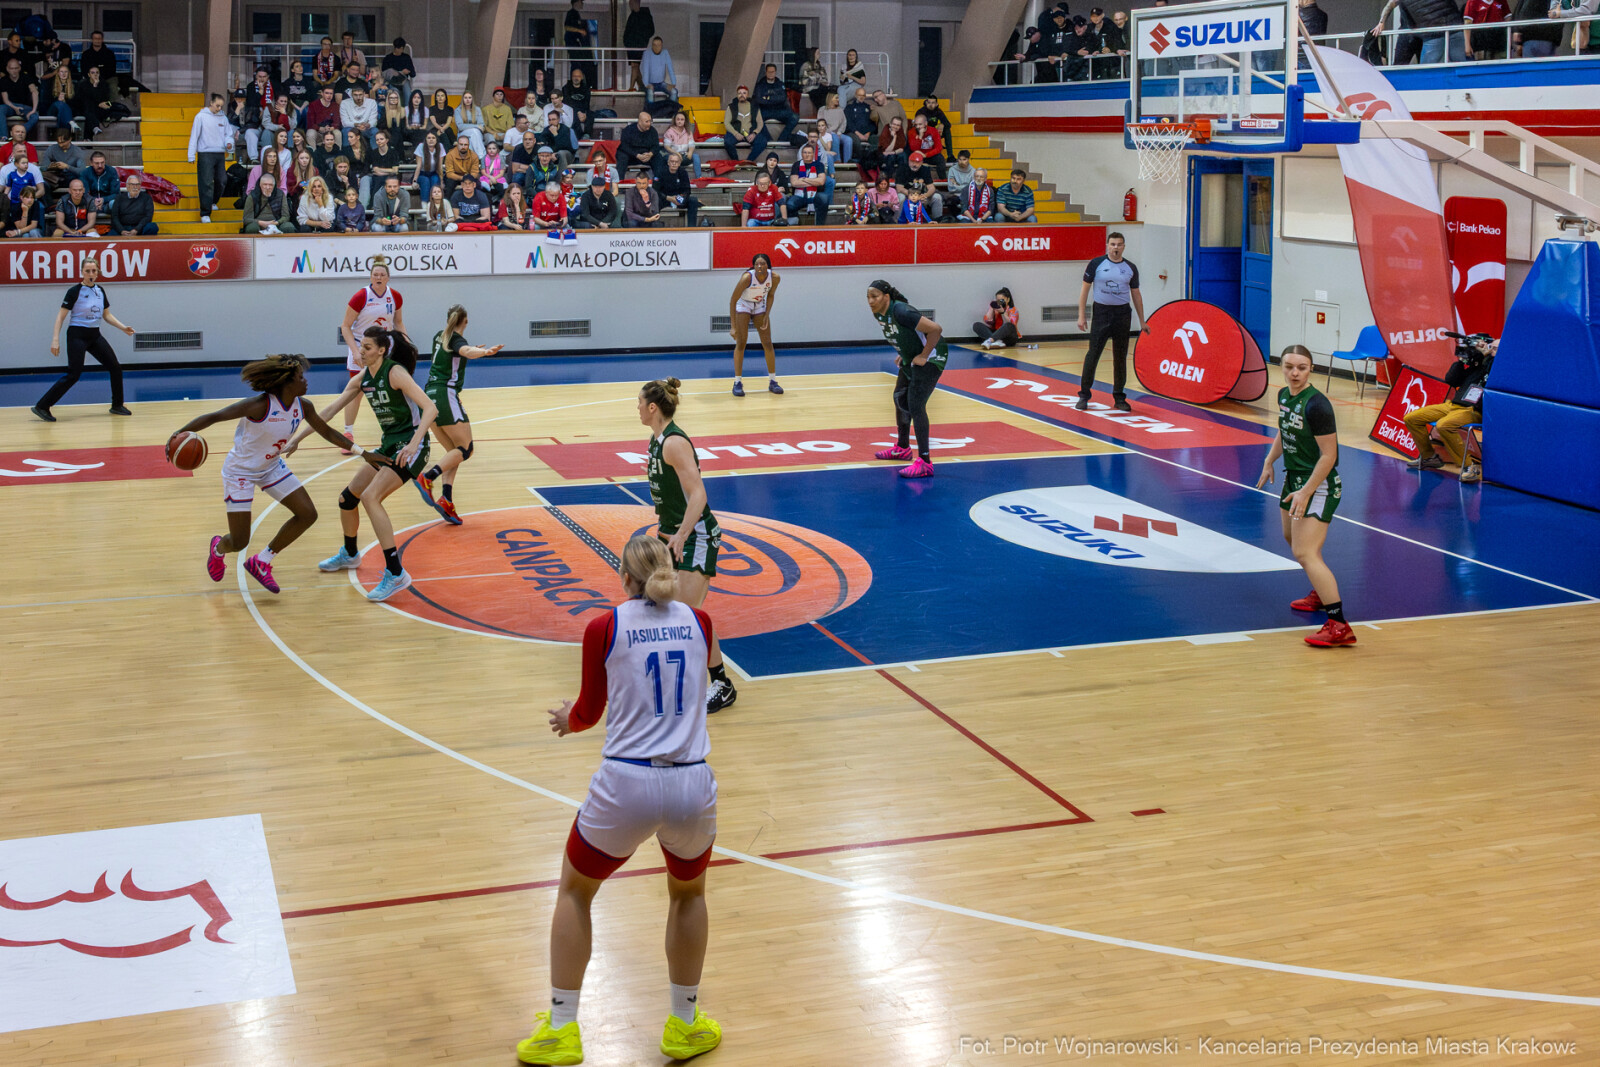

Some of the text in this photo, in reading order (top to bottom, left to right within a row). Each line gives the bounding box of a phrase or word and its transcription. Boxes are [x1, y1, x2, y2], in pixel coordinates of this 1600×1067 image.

[1175, 18, 1271, 48] SUZUKI
[1460, 223, 1501, 236] Bank Pekao
[382, 242, 454, 252] KRAKÓW REGION
[609, 239, 677, 248] KRAKÓW REGION
[803, 240, 856, 255] ORLEN
[1002, 237, 1051, 251] ORLEN
[9, 243, 151, 280] KRAKÓW
[554, 250, 681, 268] MAŁOPOLSKA
[1159, 359, 1205, 383] ORLEN
[1288, 411, 1304, 430] 95
[1378, 421, 1398, 441] Bank
[651, 458, 664, 475] 21
[999, 504, 1146, 560] SUZUKI
[495, 528, 618, 616] CANPACK
[626, 626, 693, 648] JASIULEWICZ
[645, 650, 686, 717] 17
